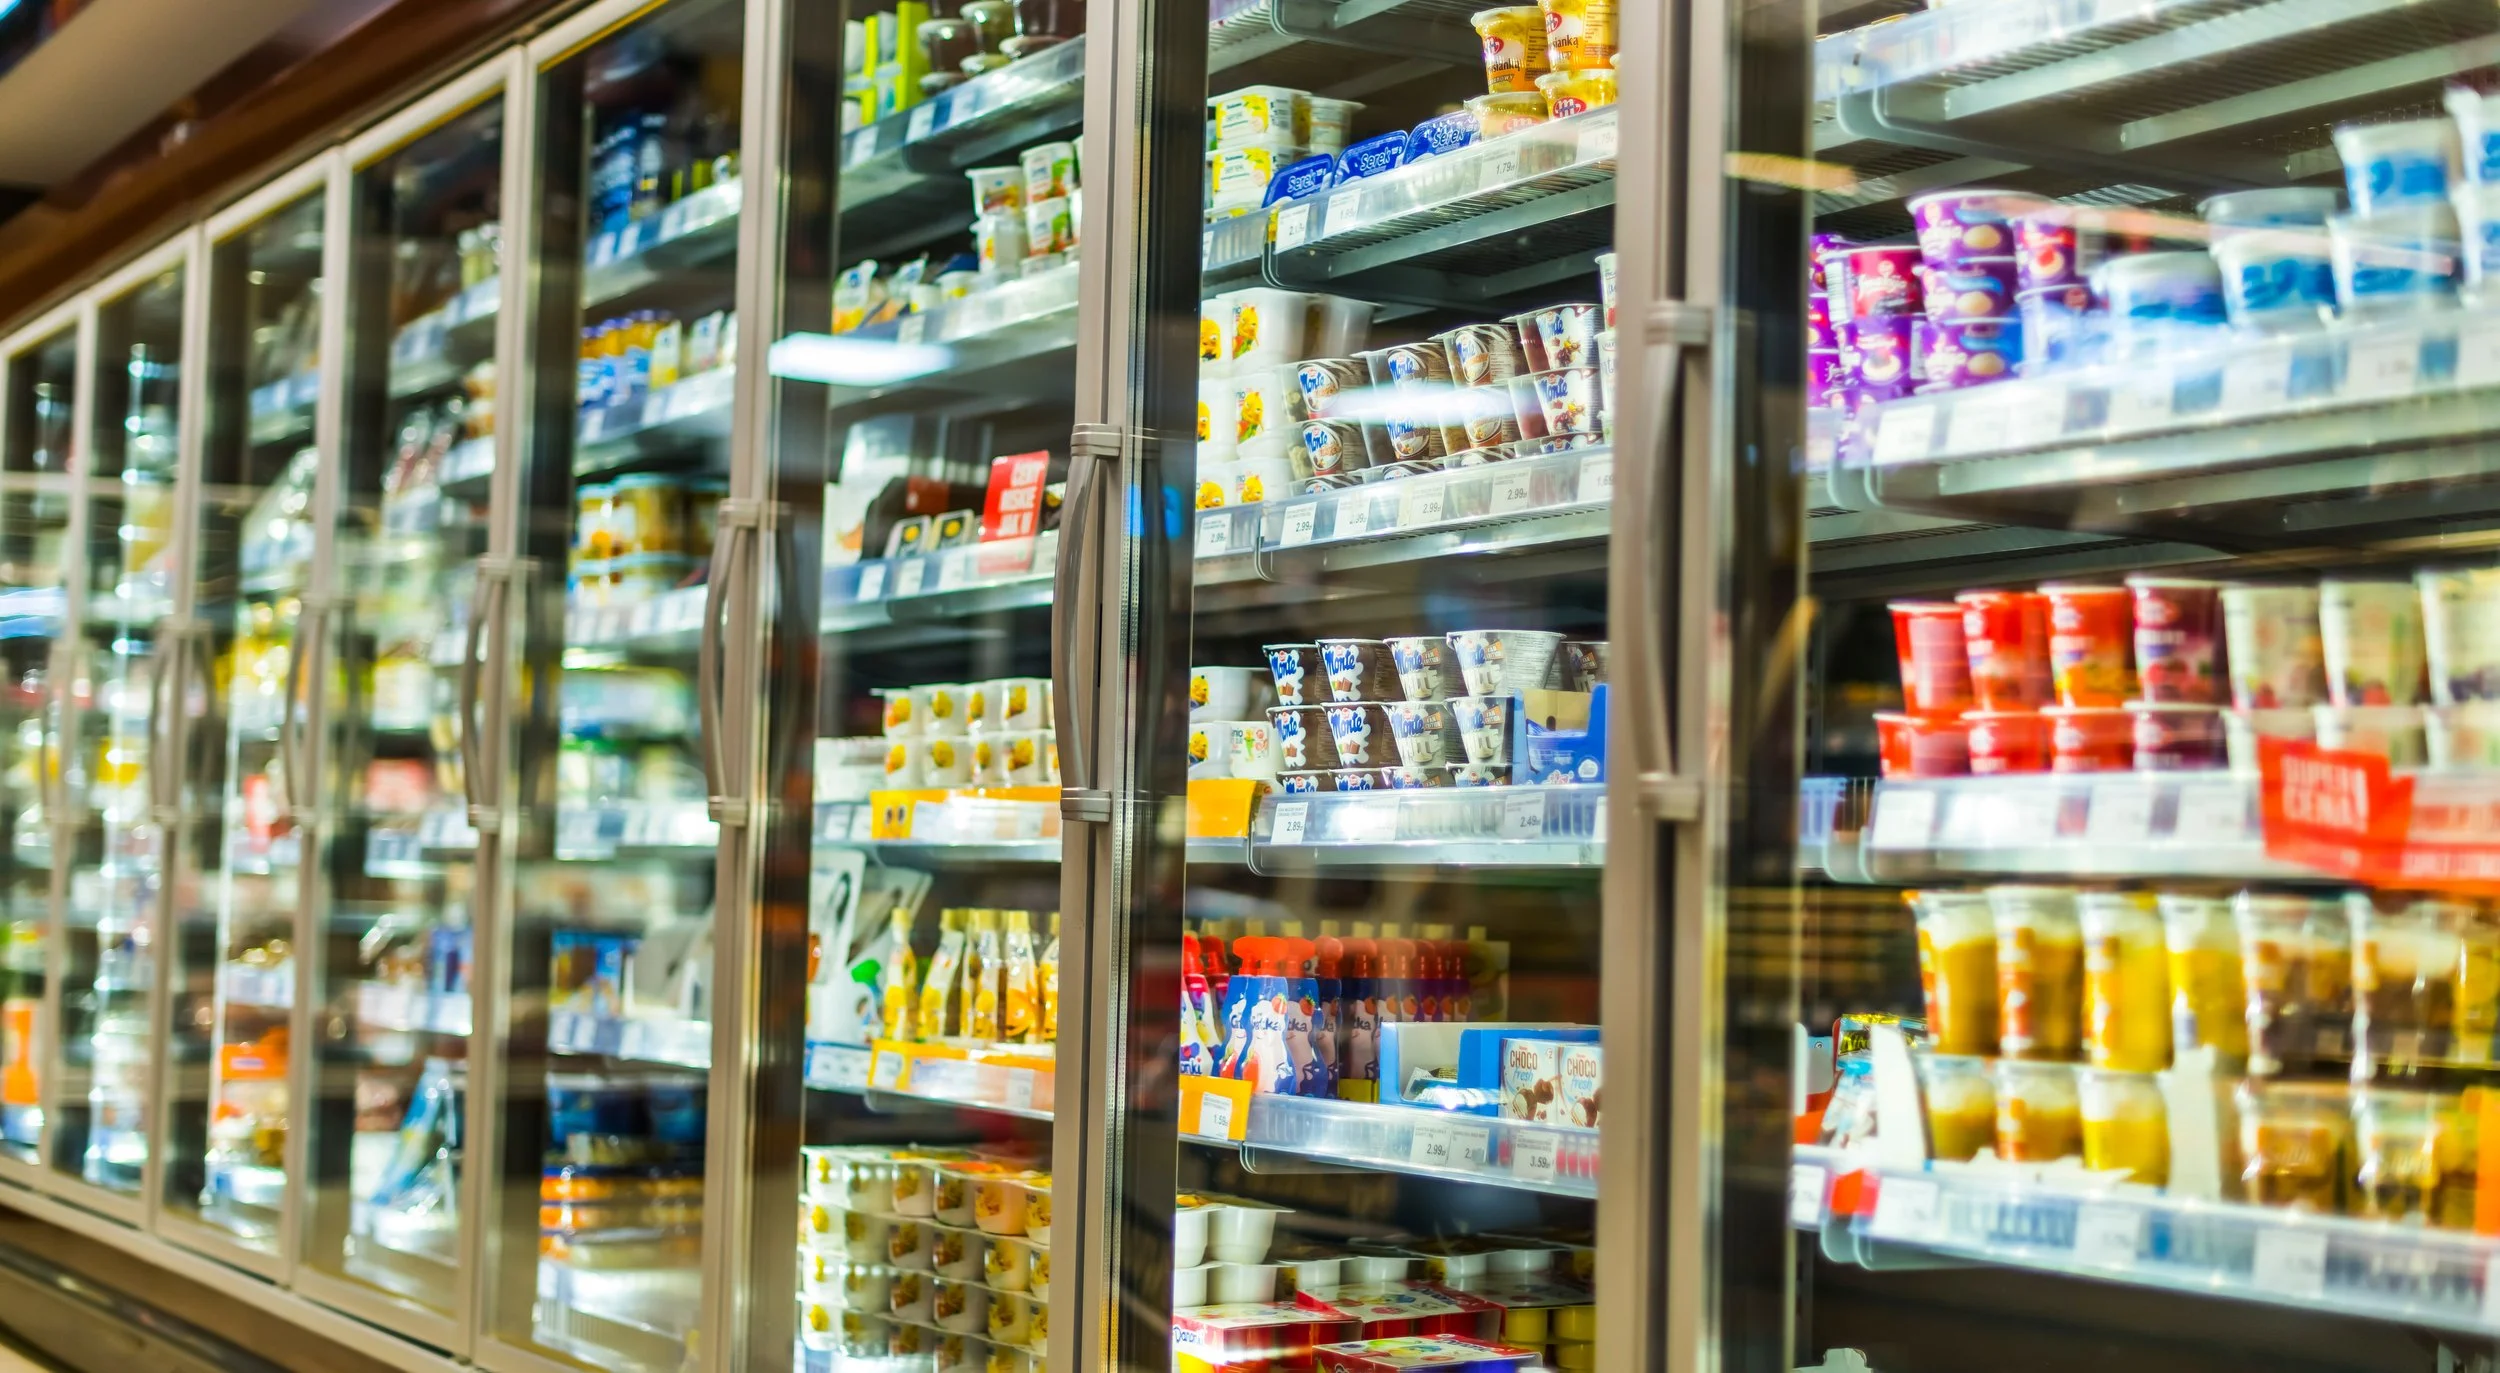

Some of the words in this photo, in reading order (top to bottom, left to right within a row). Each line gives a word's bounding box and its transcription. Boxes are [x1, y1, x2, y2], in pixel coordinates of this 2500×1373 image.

[1432, 126, 1465, 148] Serek
[1360, 146, 1391, 172] Serek
[1287, 169, 1315, 192] Serek
[1540, 316, 1564, 335] Monte
[1389, 357, 1415, 380] Monte
[1300, 372, 1325, 394] Monte
[1540, 376, 1568, 402] Monte
[1305, 431, 1328, 453] Monte
[1271, 653, 1297, 681] Monte
[1324, 649, 1356, 675] Monte
[1395, 649, 1423, 675] Monte
[1276, 715, 1298, 741] Monte
[1331, 712, 1363, 740] Monte
[1391, 713, 1424, 739] Monte
[1510, 1050, 1538, 1070] CHOCO
[1567, 1058, 1597, 1078] CHOCO
[1513, 1066, 1534, 1082] fresh
[1571, 1075, 1593, 1092] fresh
